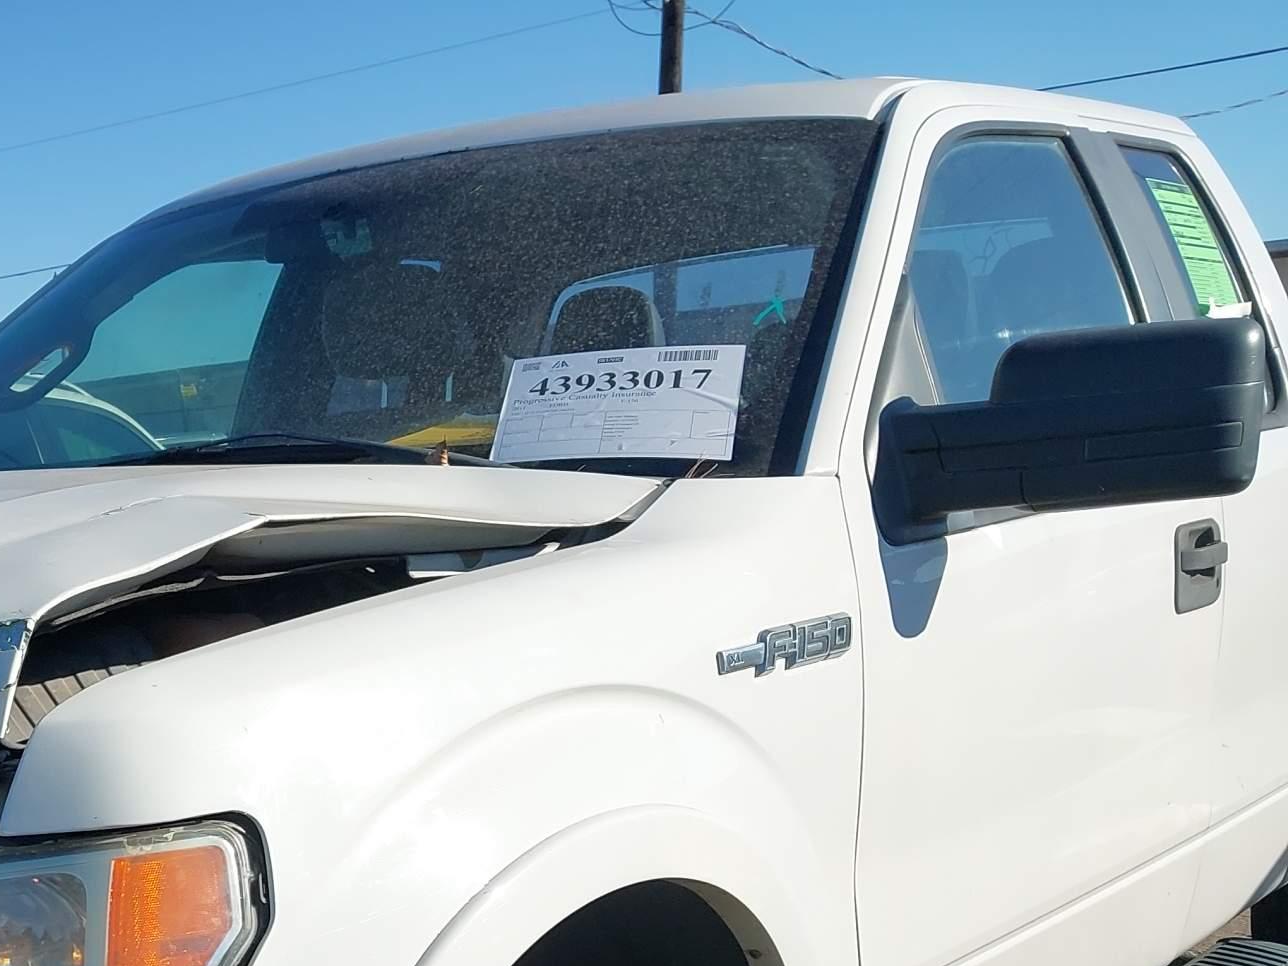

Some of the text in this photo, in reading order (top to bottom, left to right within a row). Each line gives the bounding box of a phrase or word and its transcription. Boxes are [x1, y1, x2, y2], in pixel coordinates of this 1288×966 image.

[528, 369, 713, 396] 43933017
[513, 396, 567, 406] Progressive
[569, 391, 609, 401] Casualty
[611, 390, 657, 399] Insurance
